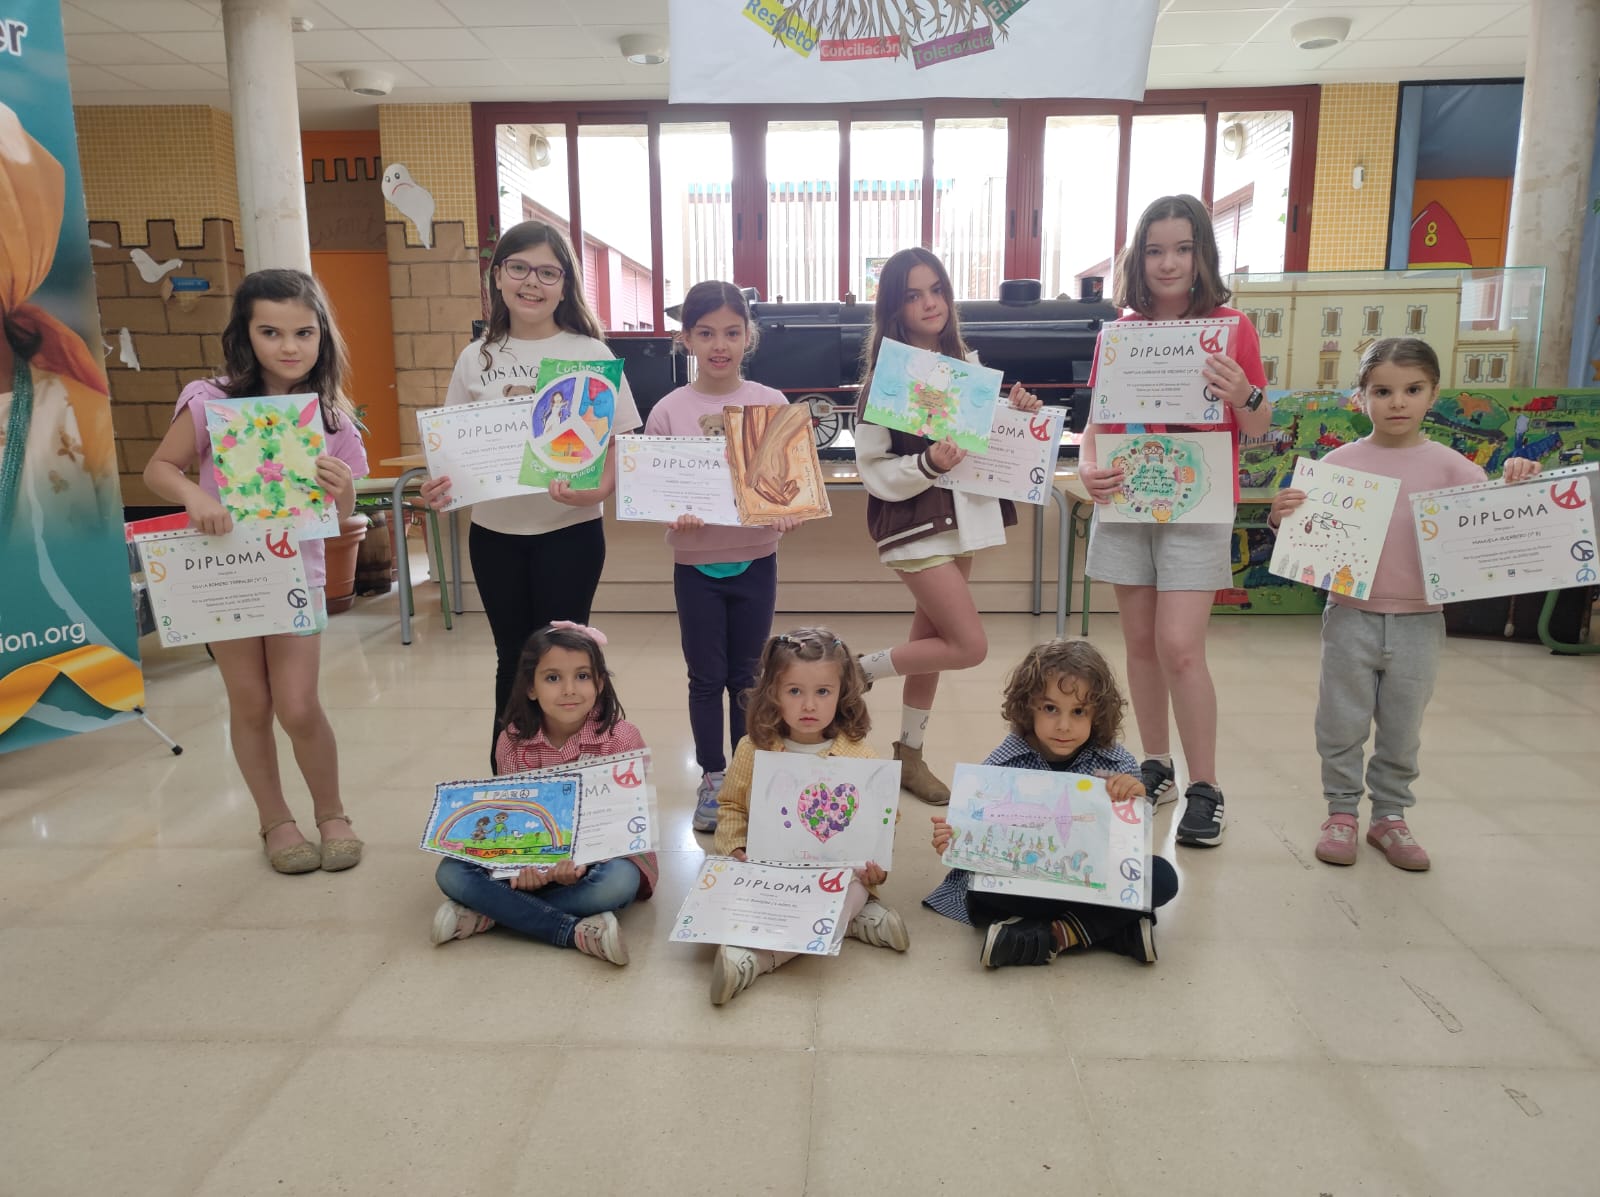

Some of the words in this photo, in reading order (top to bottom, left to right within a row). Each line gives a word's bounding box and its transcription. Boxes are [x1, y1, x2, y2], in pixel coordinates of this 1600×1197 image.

[746, 0, 816, 51] Respeto
[1130, 345, 1195, 358] DIPLOMA
[480, 367, 506, 387] LOS
[458, 420, 529, 440] DIPLOMA
[652, 457, 721, 470] DIPLOMA
[1332, 473, 1355, 487] PAZ
[1306, 487, 1367, 512] COLOR
[1458, 503, 1548, 528] DIPLOMA
[185, 551, 265, 570] DIPLOMA
[733, 876, 811, 894] DIPLOMA
